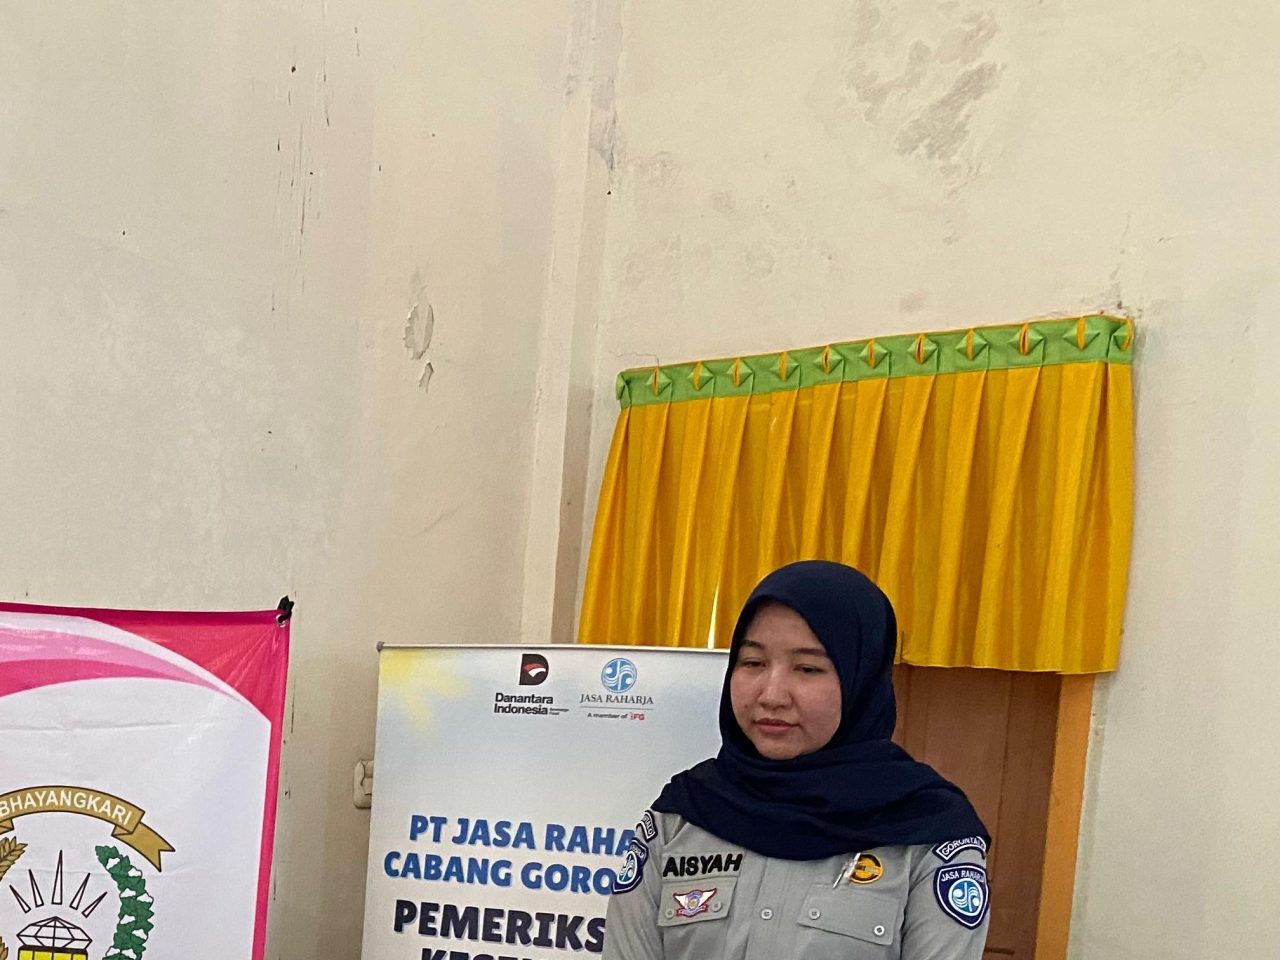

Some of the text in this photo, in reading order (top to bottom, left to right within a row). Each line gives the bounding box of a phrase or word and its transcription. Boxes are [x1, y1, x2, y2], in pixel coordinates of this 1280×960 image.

[495, 692, 554, 705] Danantara
[580, 693, 654, 706] JASA RAHARJA
[494, 703, 549, 716] Indonesia
[409, 814, 448, 843] PT
[452, 817, 536, 849] JASA
[544, 823, 636, 856] RAHA
[384, 851, 617, 896] CABANG GORO
[662, 853, 743, 878] AISYAH
[940, 870, 960, 882] JASA
[393, 899, 606, 952] PEMERIKS
